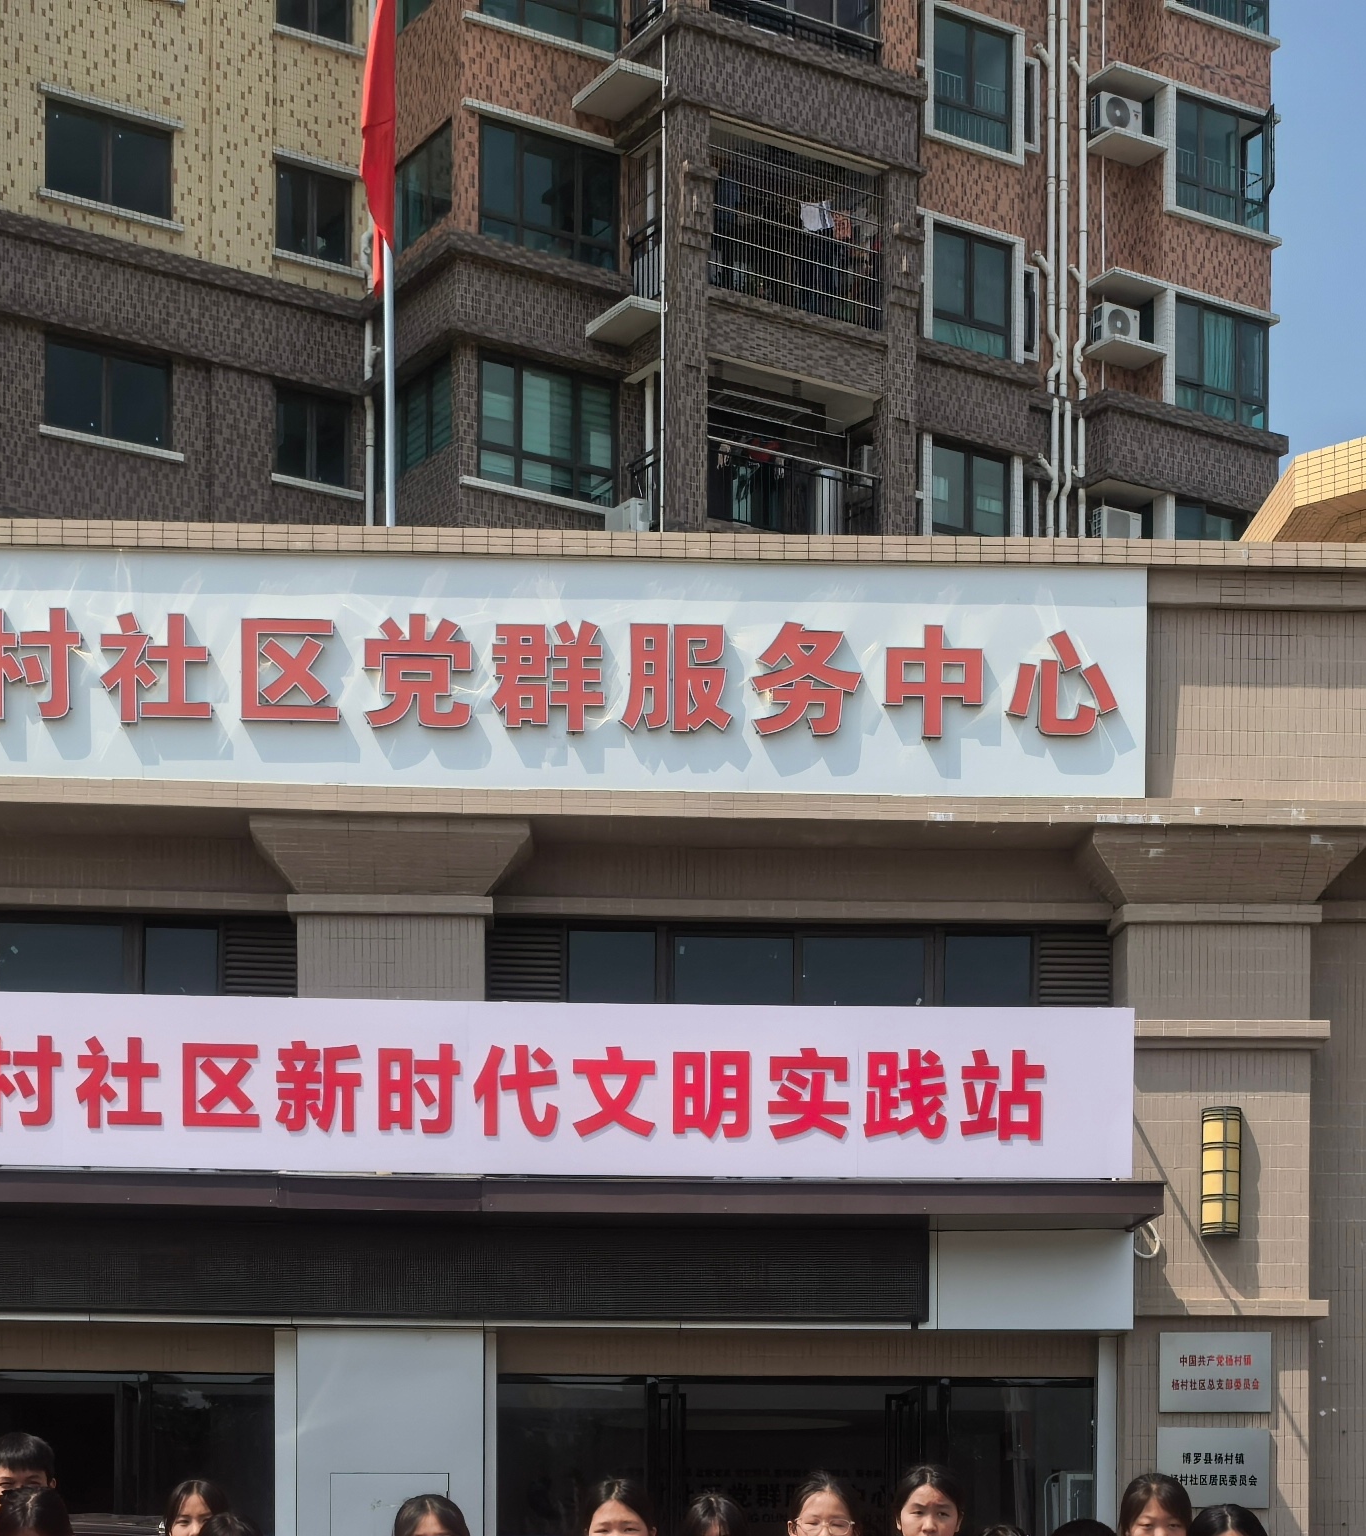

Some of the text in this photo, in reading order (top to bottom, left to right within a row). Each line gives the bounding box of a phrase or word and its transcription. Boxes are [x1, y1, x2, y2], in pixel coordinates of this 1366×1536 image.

[1179, 1354, 1252, 1367] 中国共产党杨村镇
[1171, 1378, 1260, 1391] 杨村社区总支部委员会
[1182, 1452, 1245, 1465] 博罗县杨村镇
